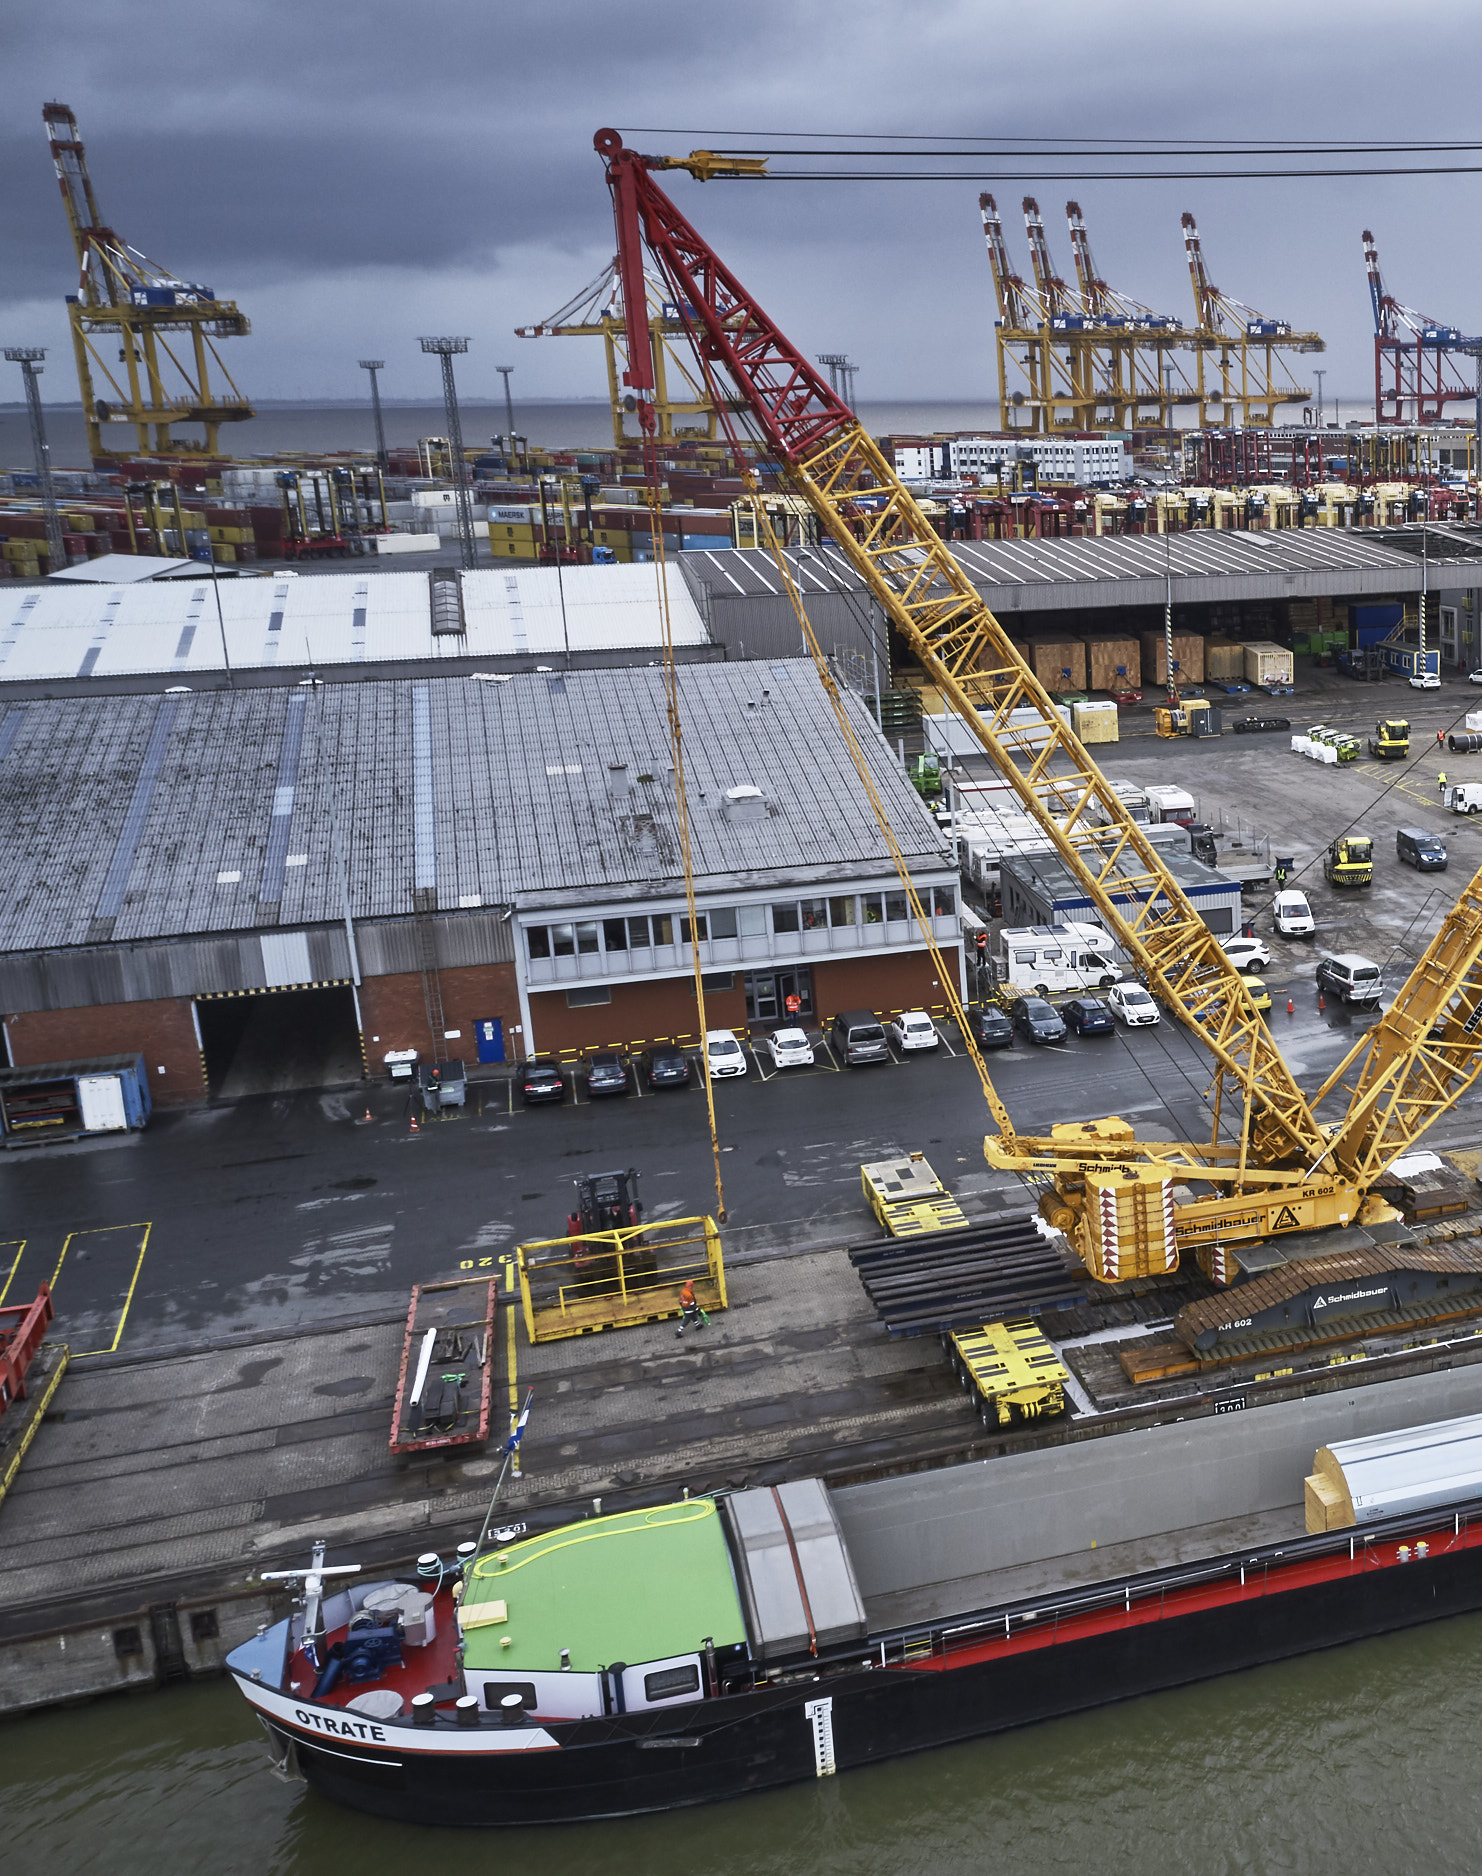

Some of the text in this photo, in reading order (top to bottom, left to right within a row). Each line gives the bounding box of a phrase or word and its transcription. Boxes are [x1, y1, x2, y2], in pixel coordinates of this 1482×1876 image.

[498, 511, 525, 519] MAERSK
[1078, 1162, 1130, 1173] Schmidb
[1302, 1186, 1335, 1198] KR 602
[1175, 1214, 1266, 1236] Schmidbauer
[1327, 1286, 1388, 1304] Schmidbauer
[1234, 1318, 1252, 1329] 602
[295, 1709, 386, 1742] OTRATE
